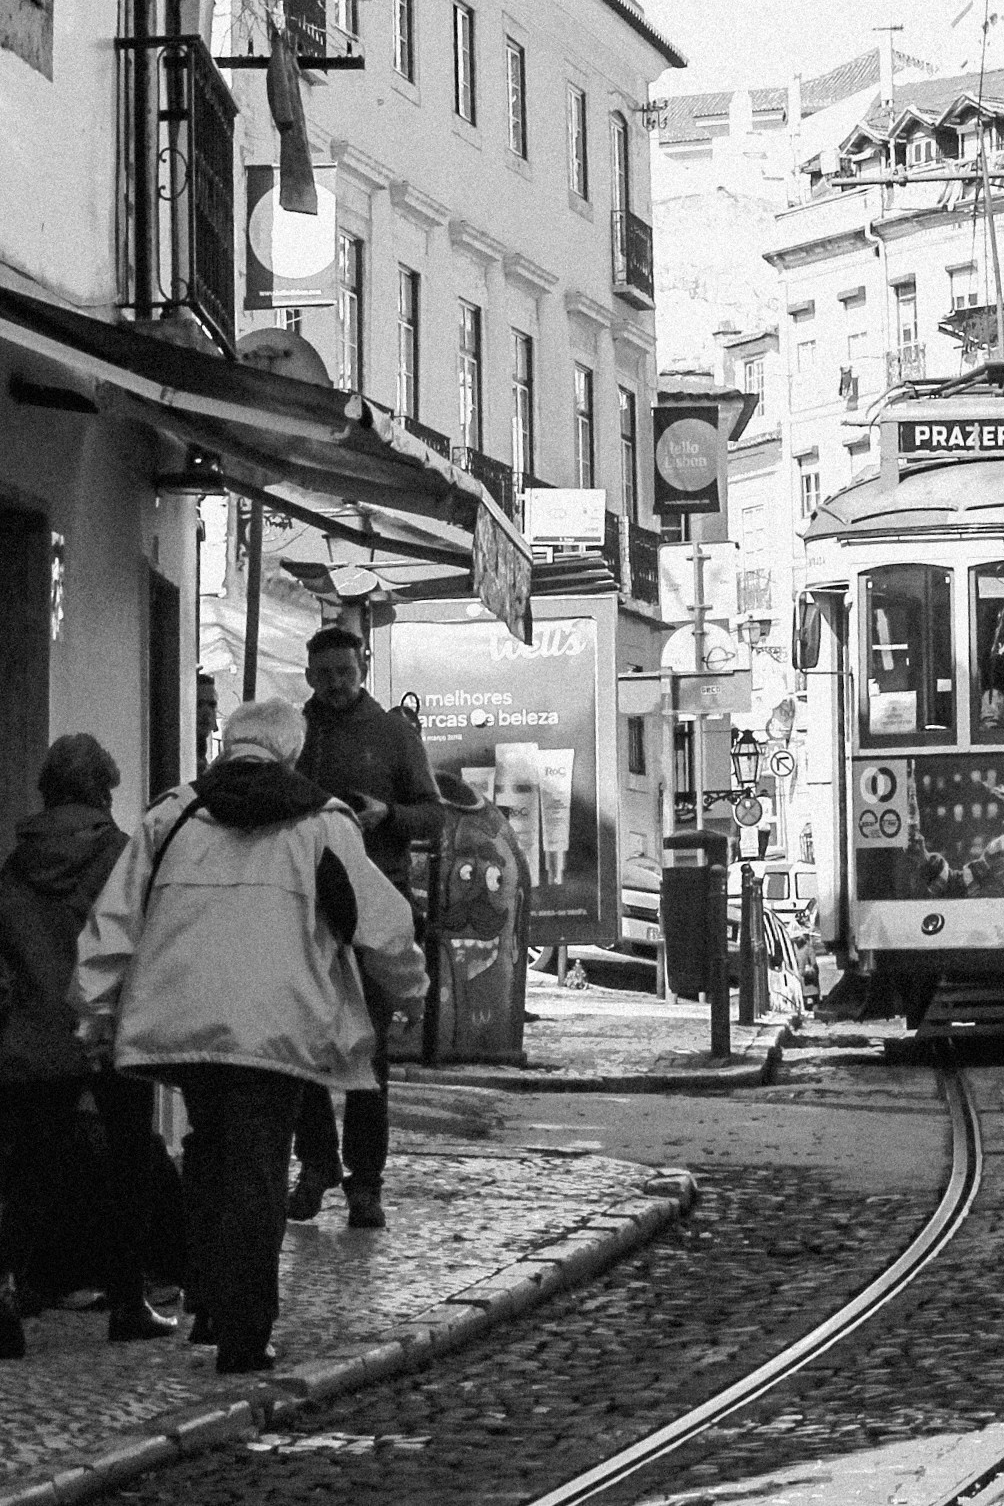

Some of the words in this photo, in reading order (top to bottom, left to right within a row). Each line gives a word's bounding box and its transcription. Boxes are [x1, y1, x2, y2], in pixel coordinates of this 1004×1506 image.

[425, 689, 513, 707] melhores
[417, 713, 468, 728] arcas
[498, 708, 560, 726] beleza
